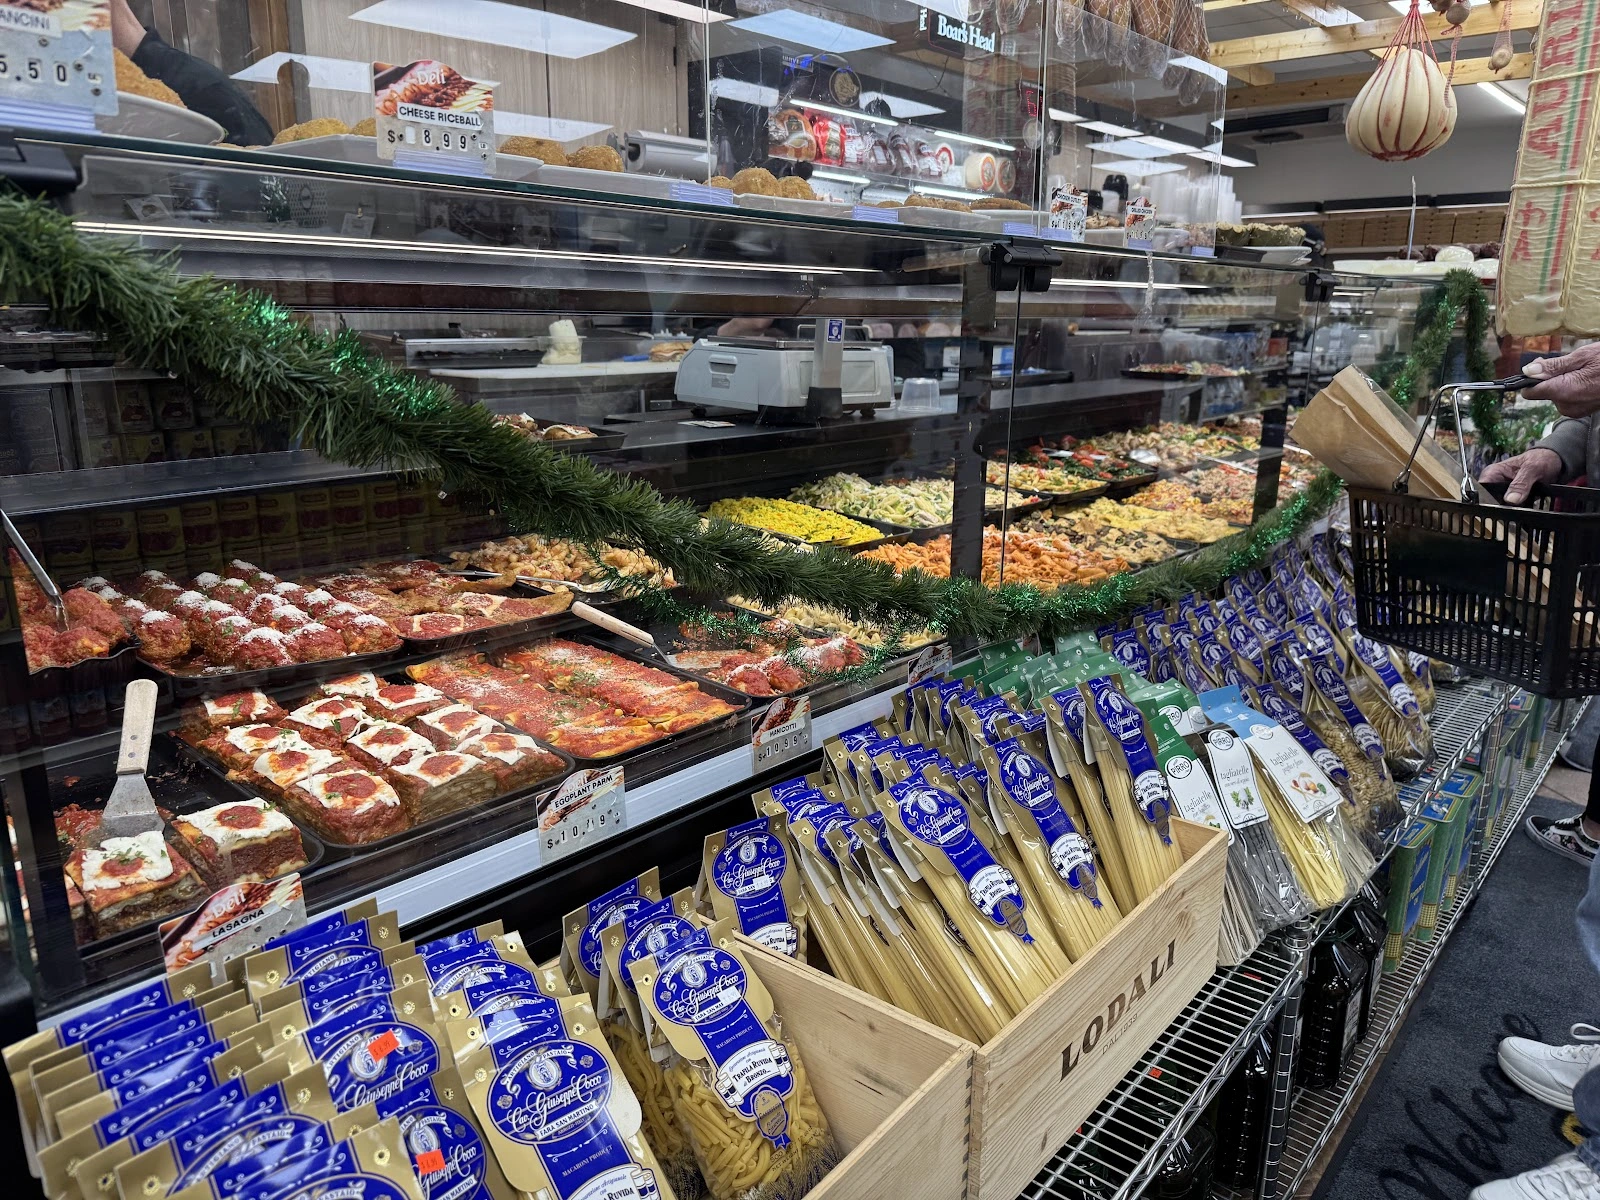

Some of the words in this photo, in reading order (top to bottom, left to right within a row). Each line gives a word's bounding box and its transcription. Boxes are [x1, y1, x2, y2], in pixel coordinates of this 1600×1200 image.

[937, 15, 968, 44] Boar's
[968, 25, 996, 53] Head
[416, 69, 446, 85] Deli
[399, 106, 436, 120] CHEESE
[438, 112, 482, 127] RICEBALL
[769, 722, 797, 738] MANICOTTI
[1170, 760, 1190, 776] PIRRO
[1269, 745, 1299, 767] tagliatelle
[1220, 764, 1249, 781] tagliatelle
[554, 785, 591, 809] EGGPLANT
[592, 775, 613, 790] PARM
[1184, 790, 1213, 813] tagliatelle
[212, 888, 248, 919] Deli
[212, 908, 265, 938] LASAGNA
[442, 967, 470, 995] ARTIGIANO
[681, 985, 721, 1017] Giuseppe
[714, 974, 739, 992] Cocco
[1060, 938, 1176, 1083] LODALI
[326, 1035, 361, 1072] ARTIGIANO
[508, 1050, 535, 1080] ARTIGIANO
[542, 1050, 568, 1059] PASTAIO
[751, 1057, 773, 1073] RUVIDA
[395, 1061, 429, 1092] Cocco
[506, 1106, 530, 1133] Cav.
[525, 1089, 577, 1131] Giuseppe
[571, 1073, 602, 1103] Cocco
[1378, 1013, 1543, 1200] Welcoe
[539, 1126, 556, 1137] FARA
[555, 1117, 568, 1128] SAN
[567, 1103, 594, 1122] MARTINO
[252, 1131, 286, 1147] PASTAIO
[449, 1144, 477, 1178] Cocco
[562, 1157, 590, 1177] MACARONI
[589, 1144, 613, 1162] PRODUCT
[451, 1177, 474, 1199] MARTINO
